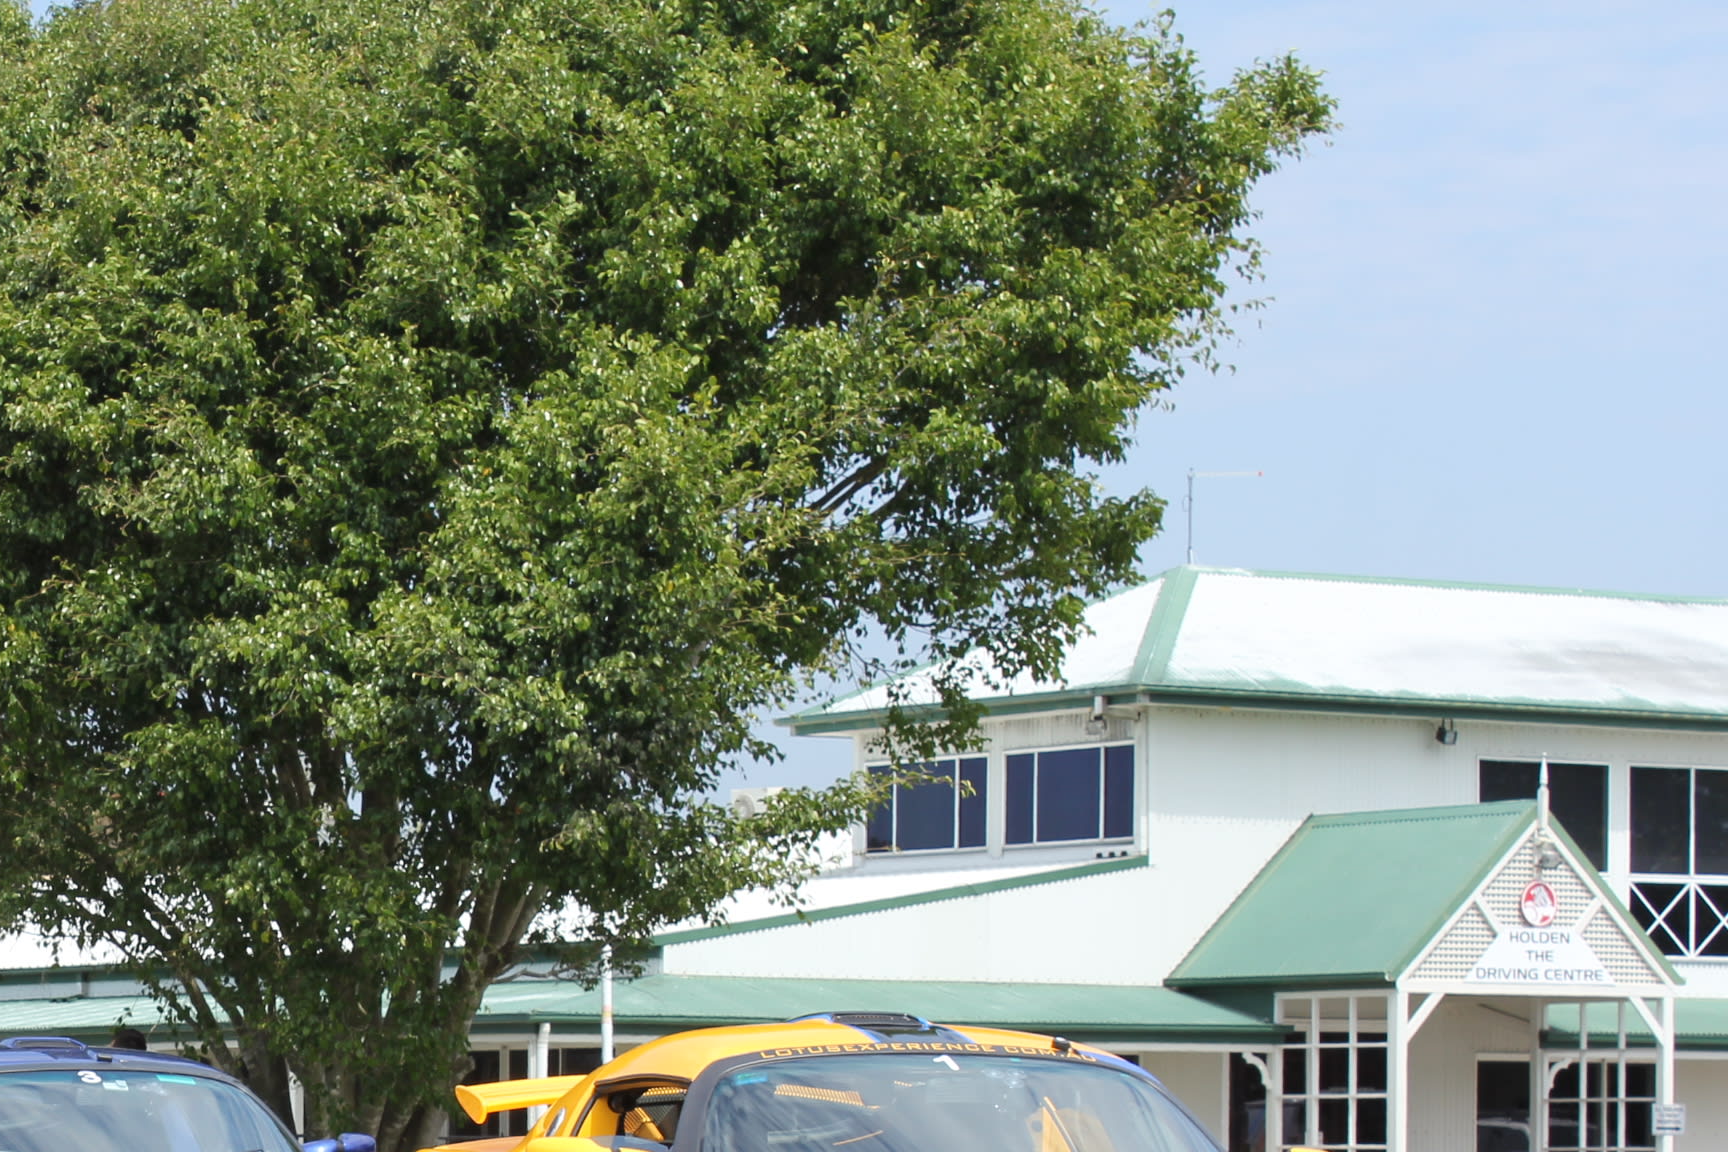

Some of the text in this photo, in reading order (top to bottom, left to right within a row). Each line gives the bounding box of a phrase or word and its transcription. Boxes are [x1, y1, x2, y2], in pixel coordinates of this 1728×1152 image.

[1509, 930, 1571, 945] HOLDEN
[1526, 949, 1554, 962] THE
[1475, 967, 1605, 982] DRIVING CENTRE
